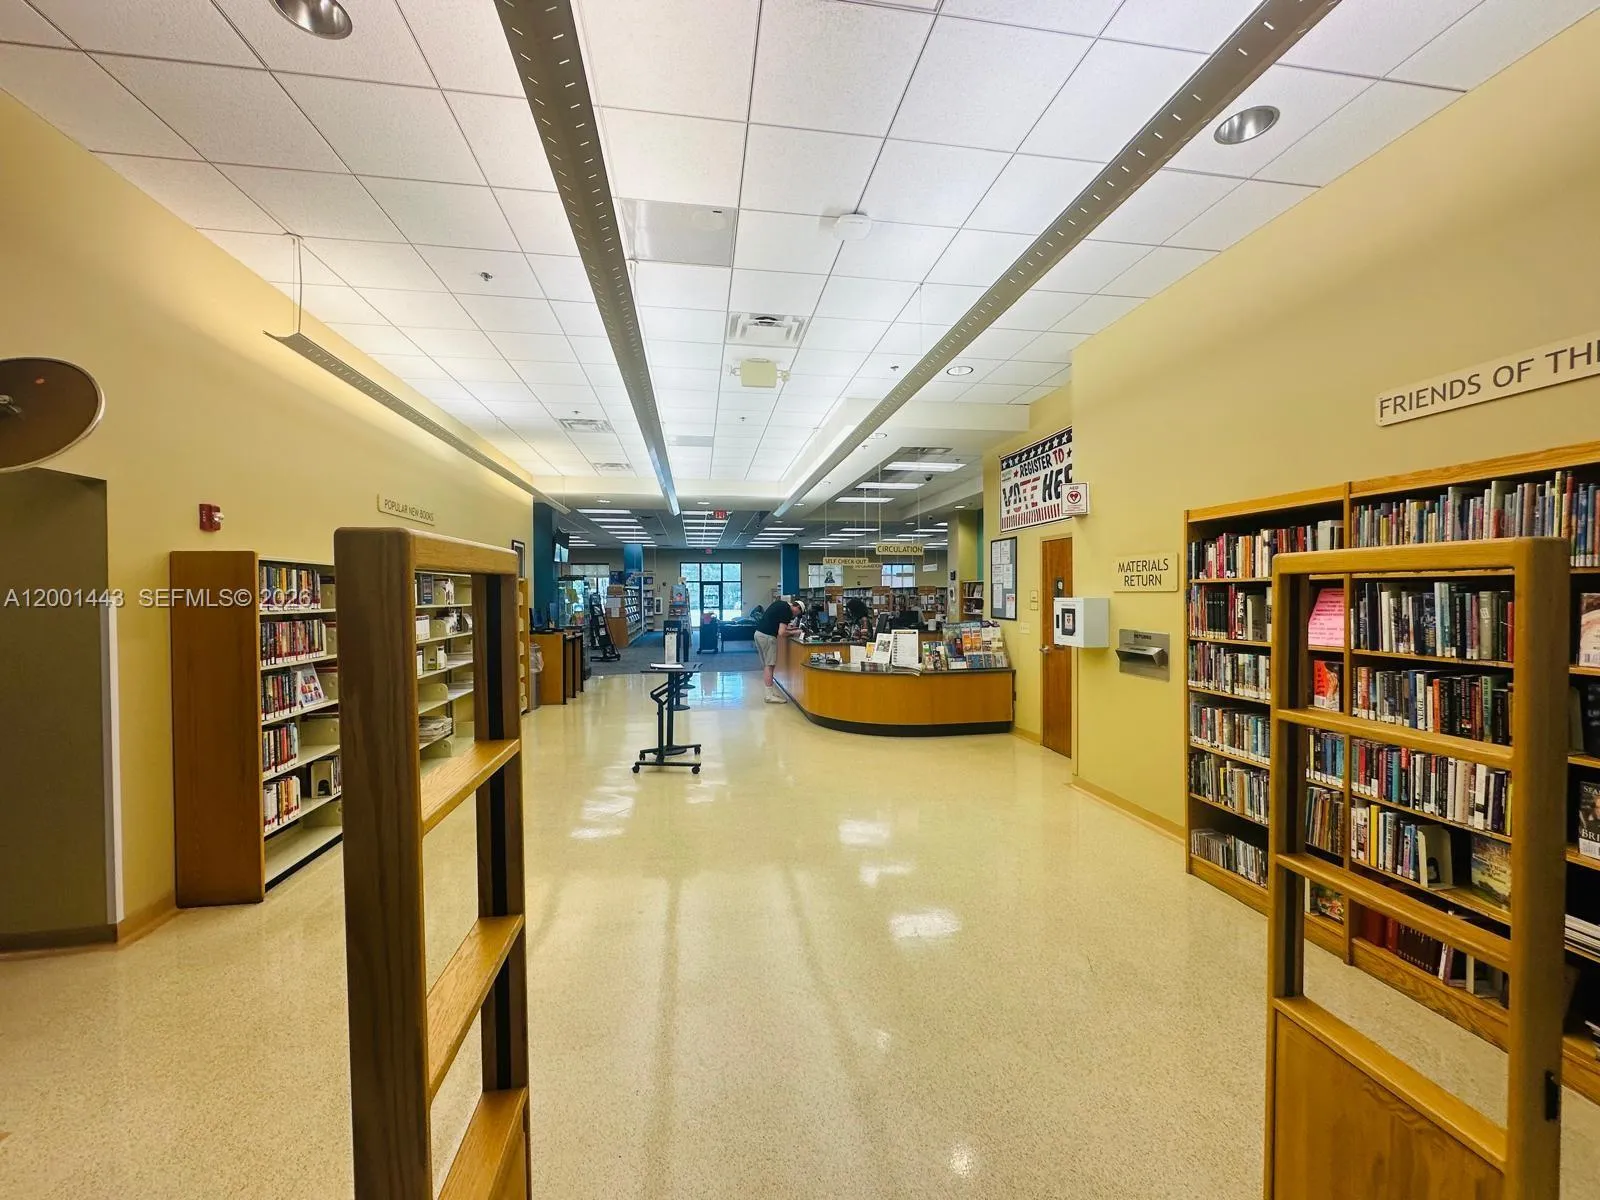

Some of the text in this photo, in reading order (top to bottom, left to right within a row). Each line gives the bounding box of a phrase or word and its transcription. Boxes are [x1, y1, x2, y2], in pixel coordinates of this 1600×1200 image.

[1379, 373, 1481, 418] FRIENDS
[1493, 358, 1535, 388] OF
[1020, 453, 1053, 478] REGISTER
[1052, 448, 1065, 464] TO
[877, 545, 923, 553] CIRCULATION
[1117, 558, 1169, 573] MATERIALS
[1124, 574, 1162, 587] RETURN
[1133, 633, 1152, 641] RETURNS
